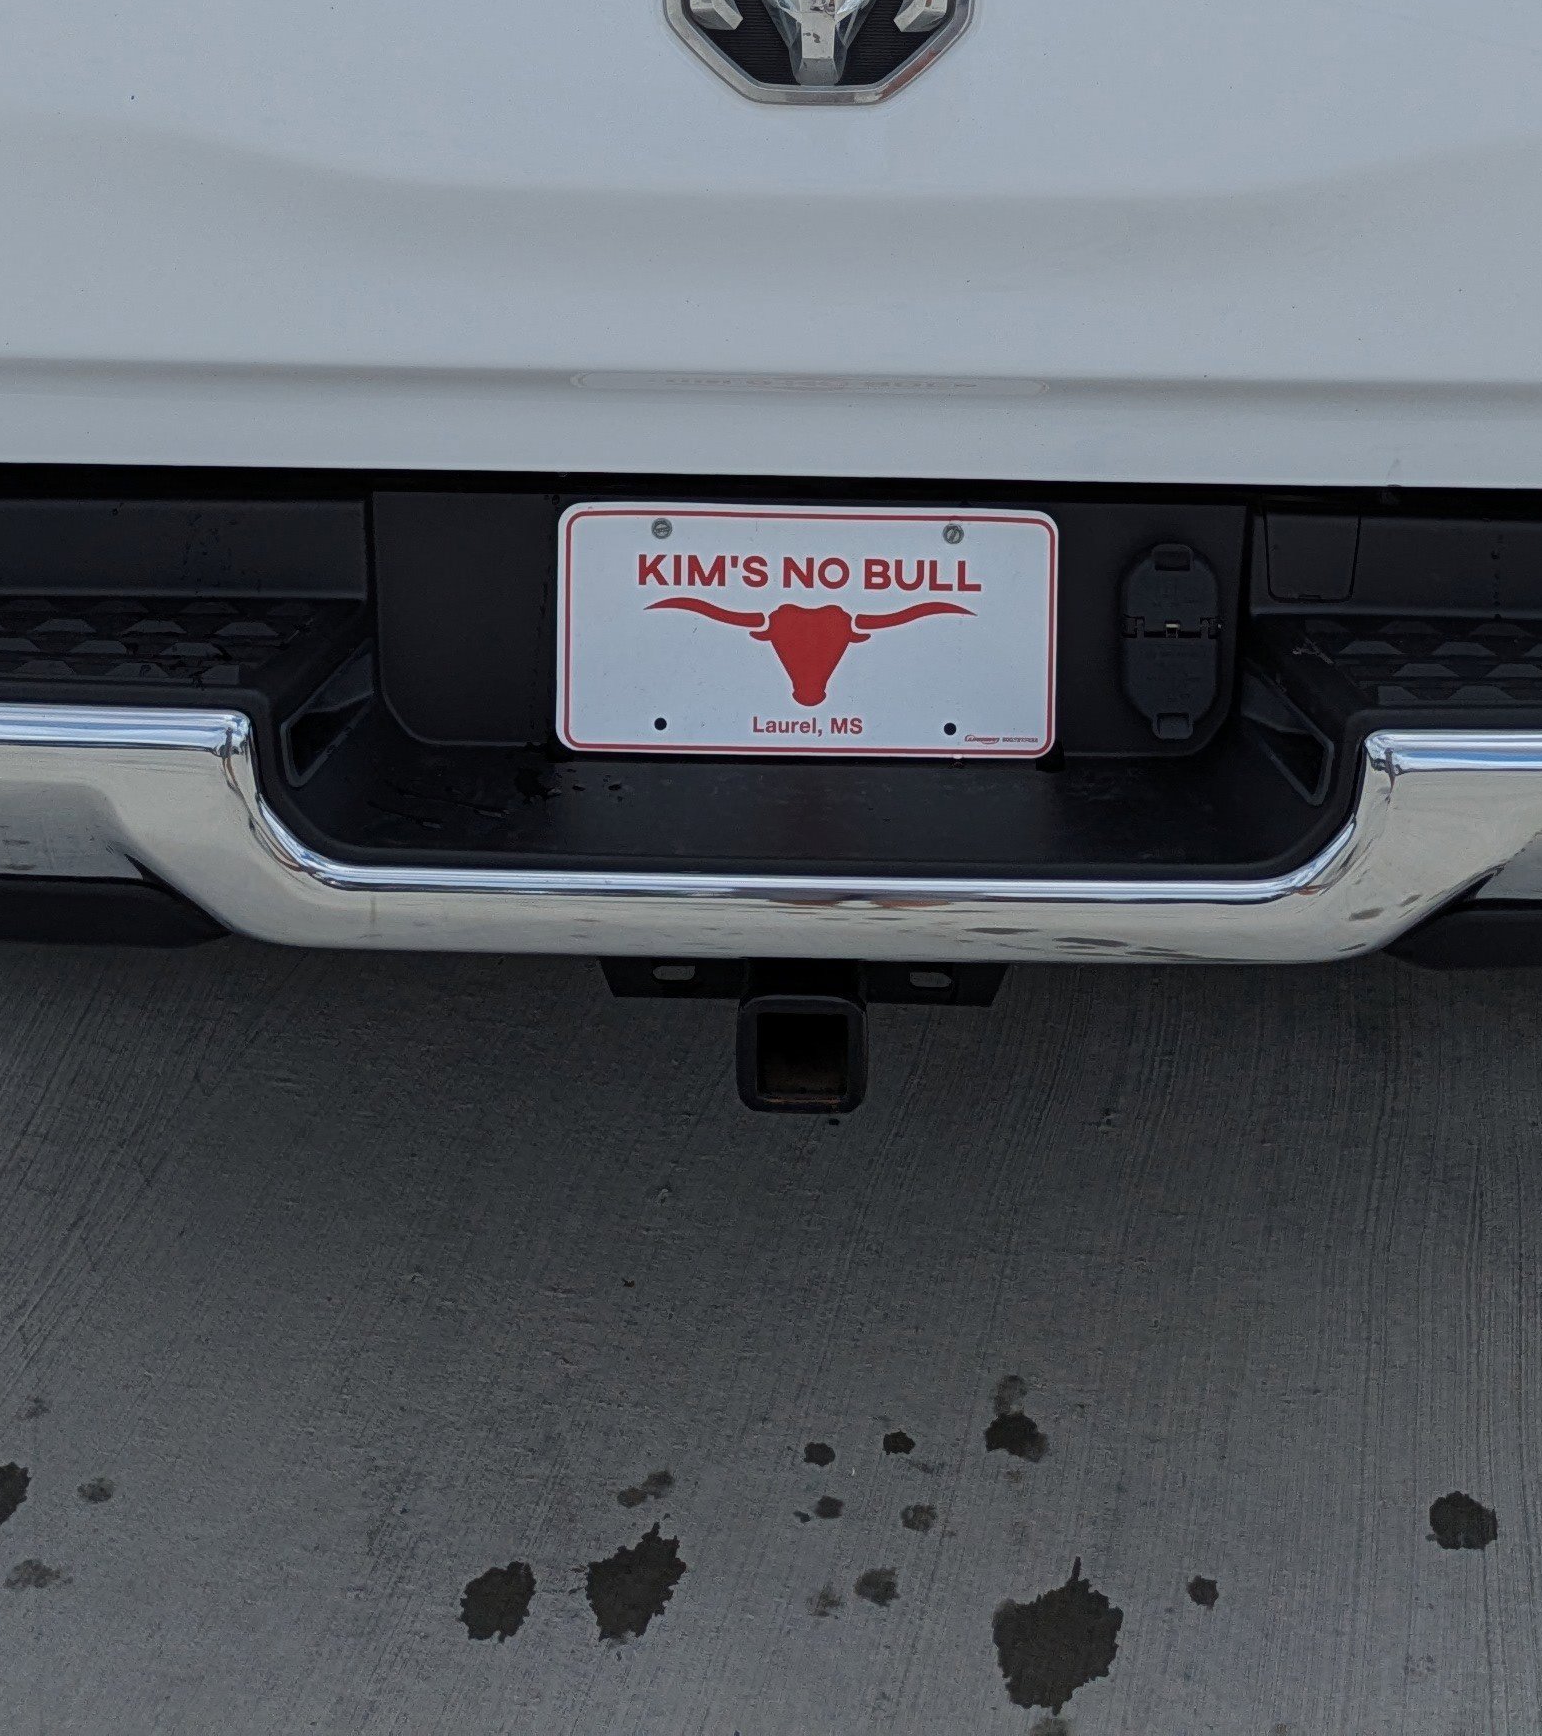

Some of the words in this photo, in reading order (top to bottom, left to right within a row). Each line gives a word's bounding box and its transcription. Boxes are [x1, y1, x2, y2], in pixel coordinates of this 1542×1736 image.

[637, 554, 768, 588] KIM'S
[783, 557, 850, 590] NO
[864, 558, 981, 592] BULL
[752, 716, 823, 738] Laurel,
[830, 718, 863, 734] MS
